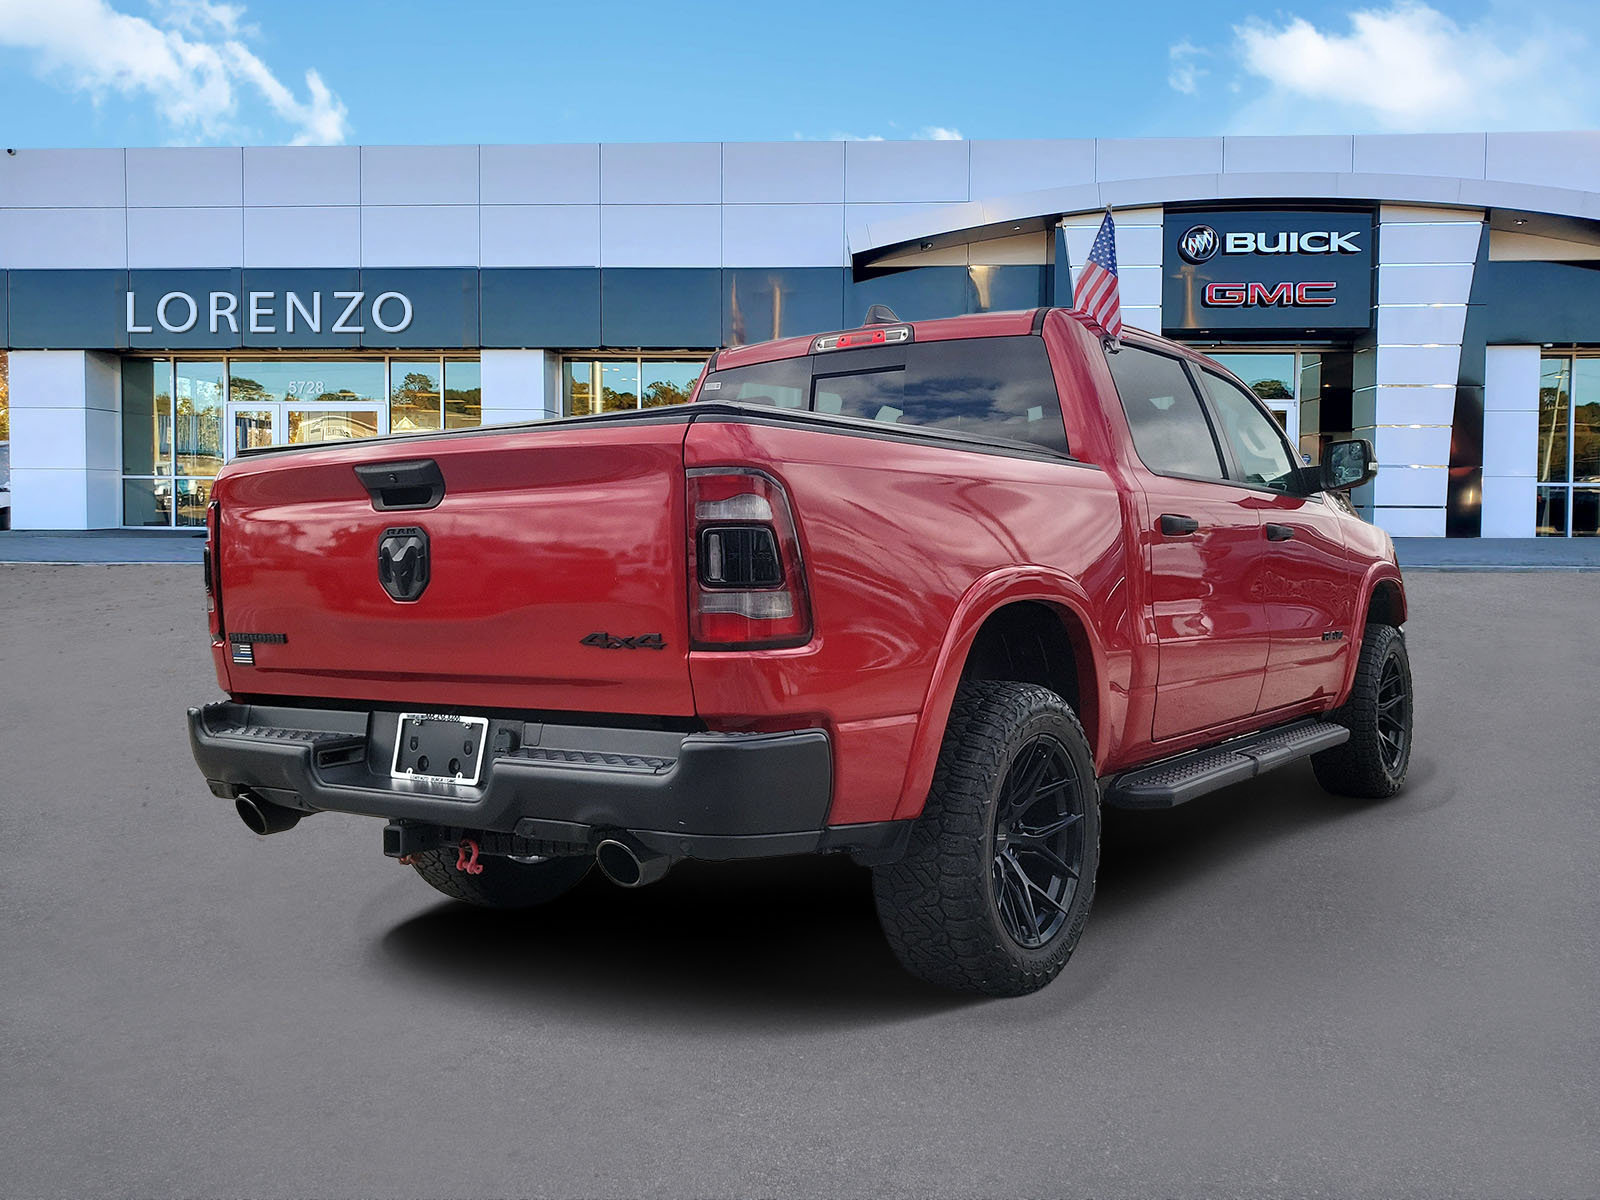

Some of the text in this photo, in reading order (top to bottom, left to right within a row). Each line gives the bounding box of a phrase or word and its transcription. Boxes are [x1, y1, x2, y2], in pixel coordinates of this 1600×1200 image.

[1226, 231, 1362, 253] BUICK
[1204, 281, 1337, 306] GMC
[126, 291, 414, 334] LORENZO
[288, 381, 325, 395] 5728
